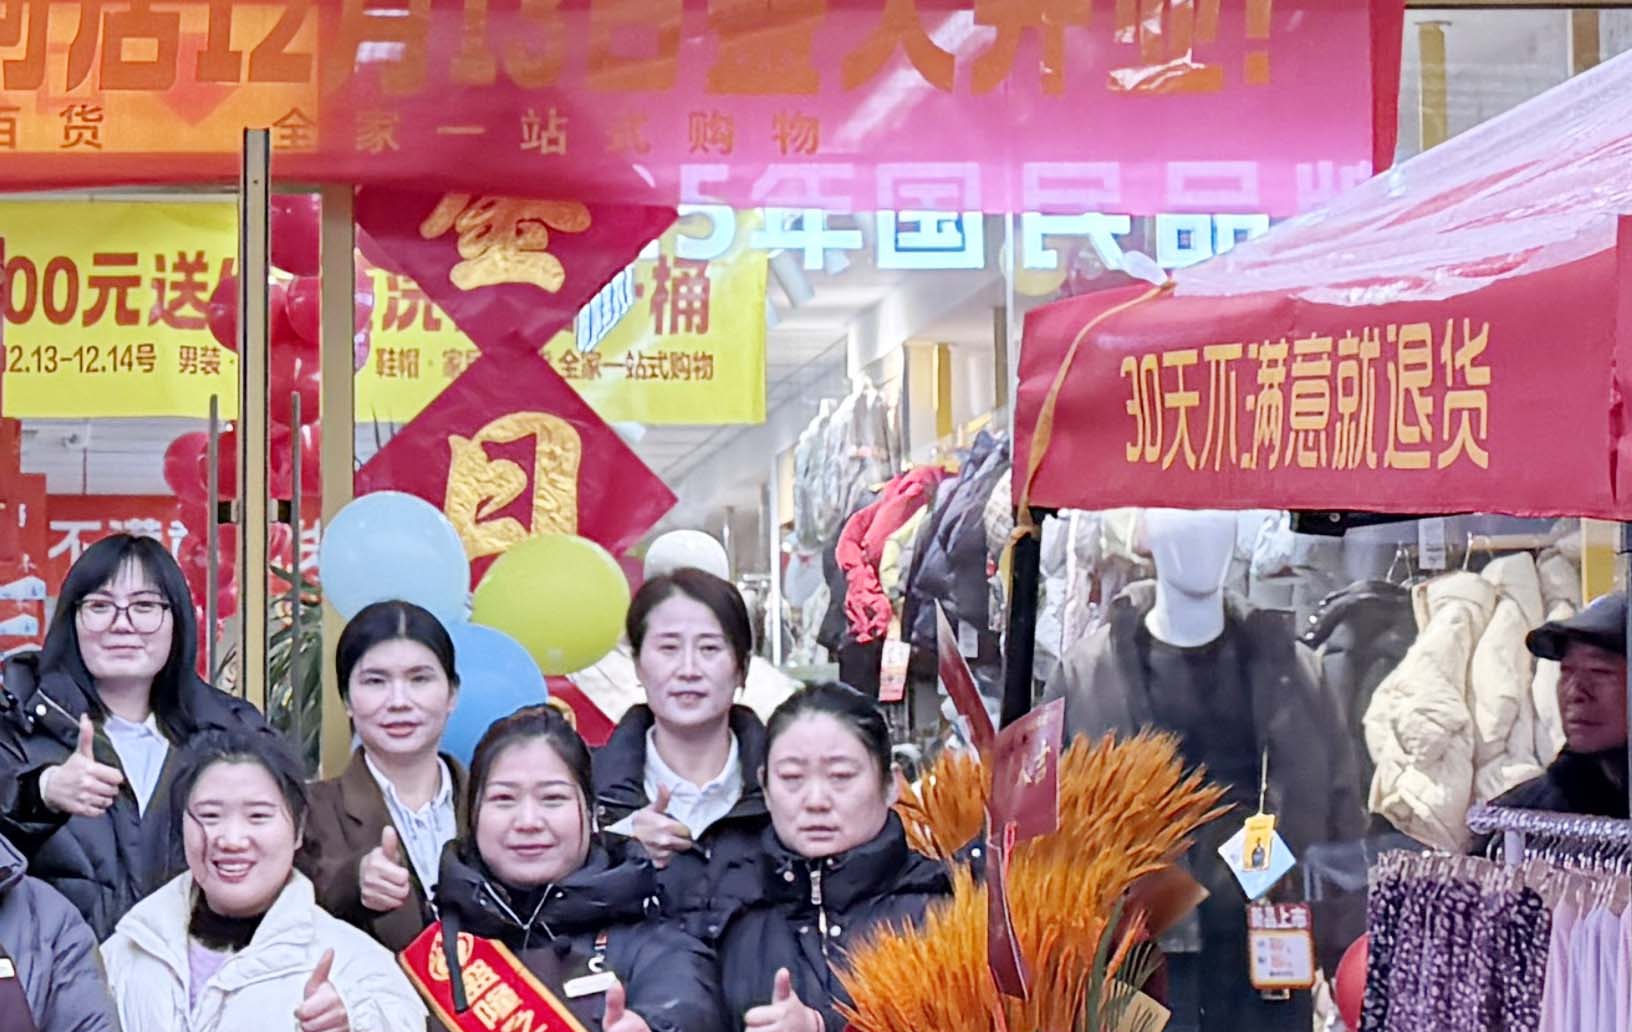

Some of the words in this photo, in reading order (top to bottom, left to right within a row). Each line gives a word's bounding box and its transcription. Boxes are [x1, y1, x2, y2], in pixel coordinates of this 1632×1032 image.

[1119, 317, 1493, 472] 30天不满意就退货
